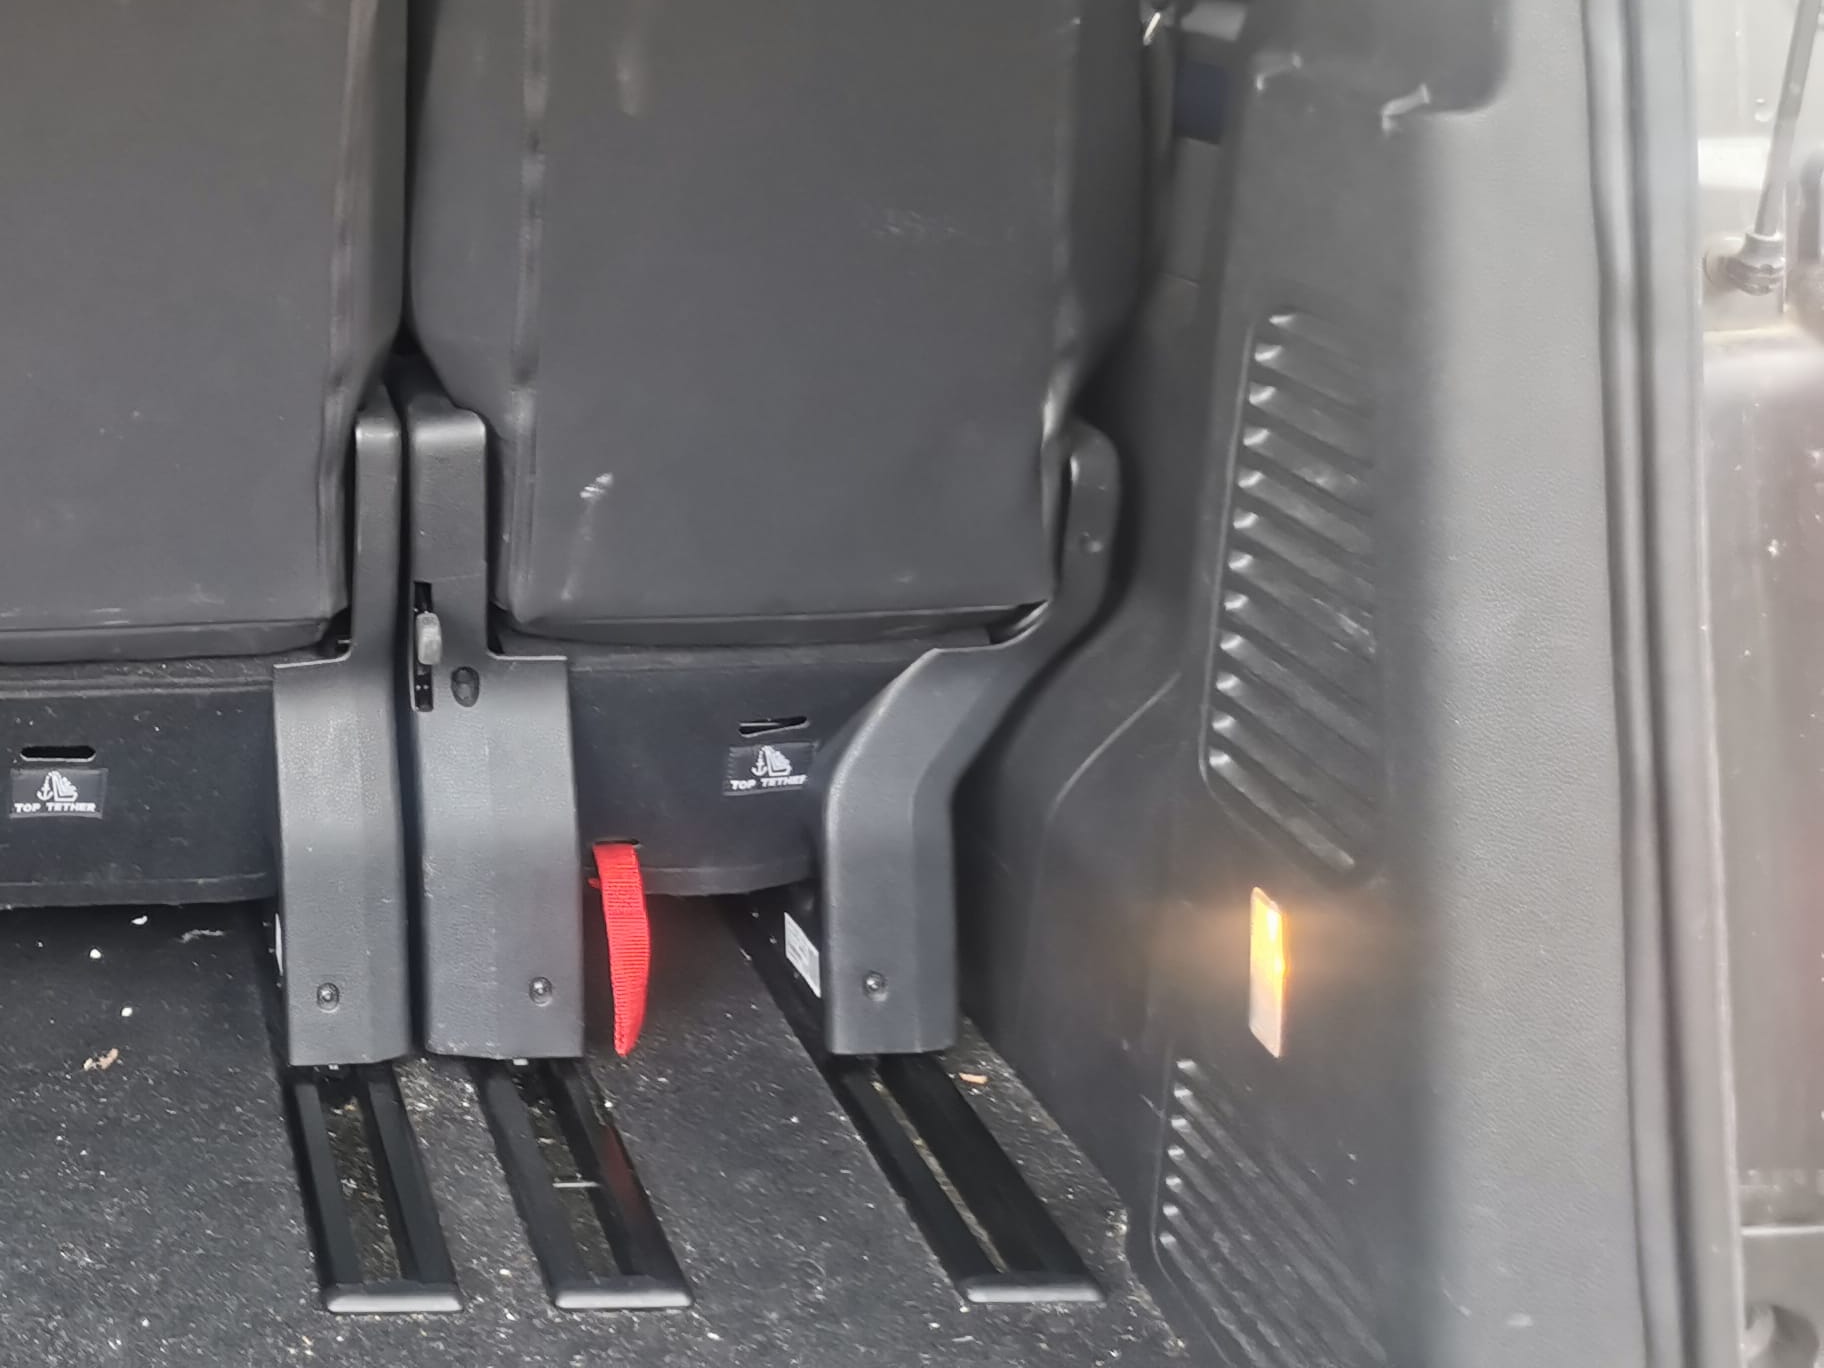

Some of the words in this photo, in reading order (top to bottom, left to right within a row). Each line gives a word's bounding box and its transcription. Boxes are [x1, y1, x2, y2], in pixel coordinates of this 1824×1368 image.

[729, 779, 757, 790] TOP
[14, 803, 41, 813] TOP
[46, 802, 96, 813] TETHER
